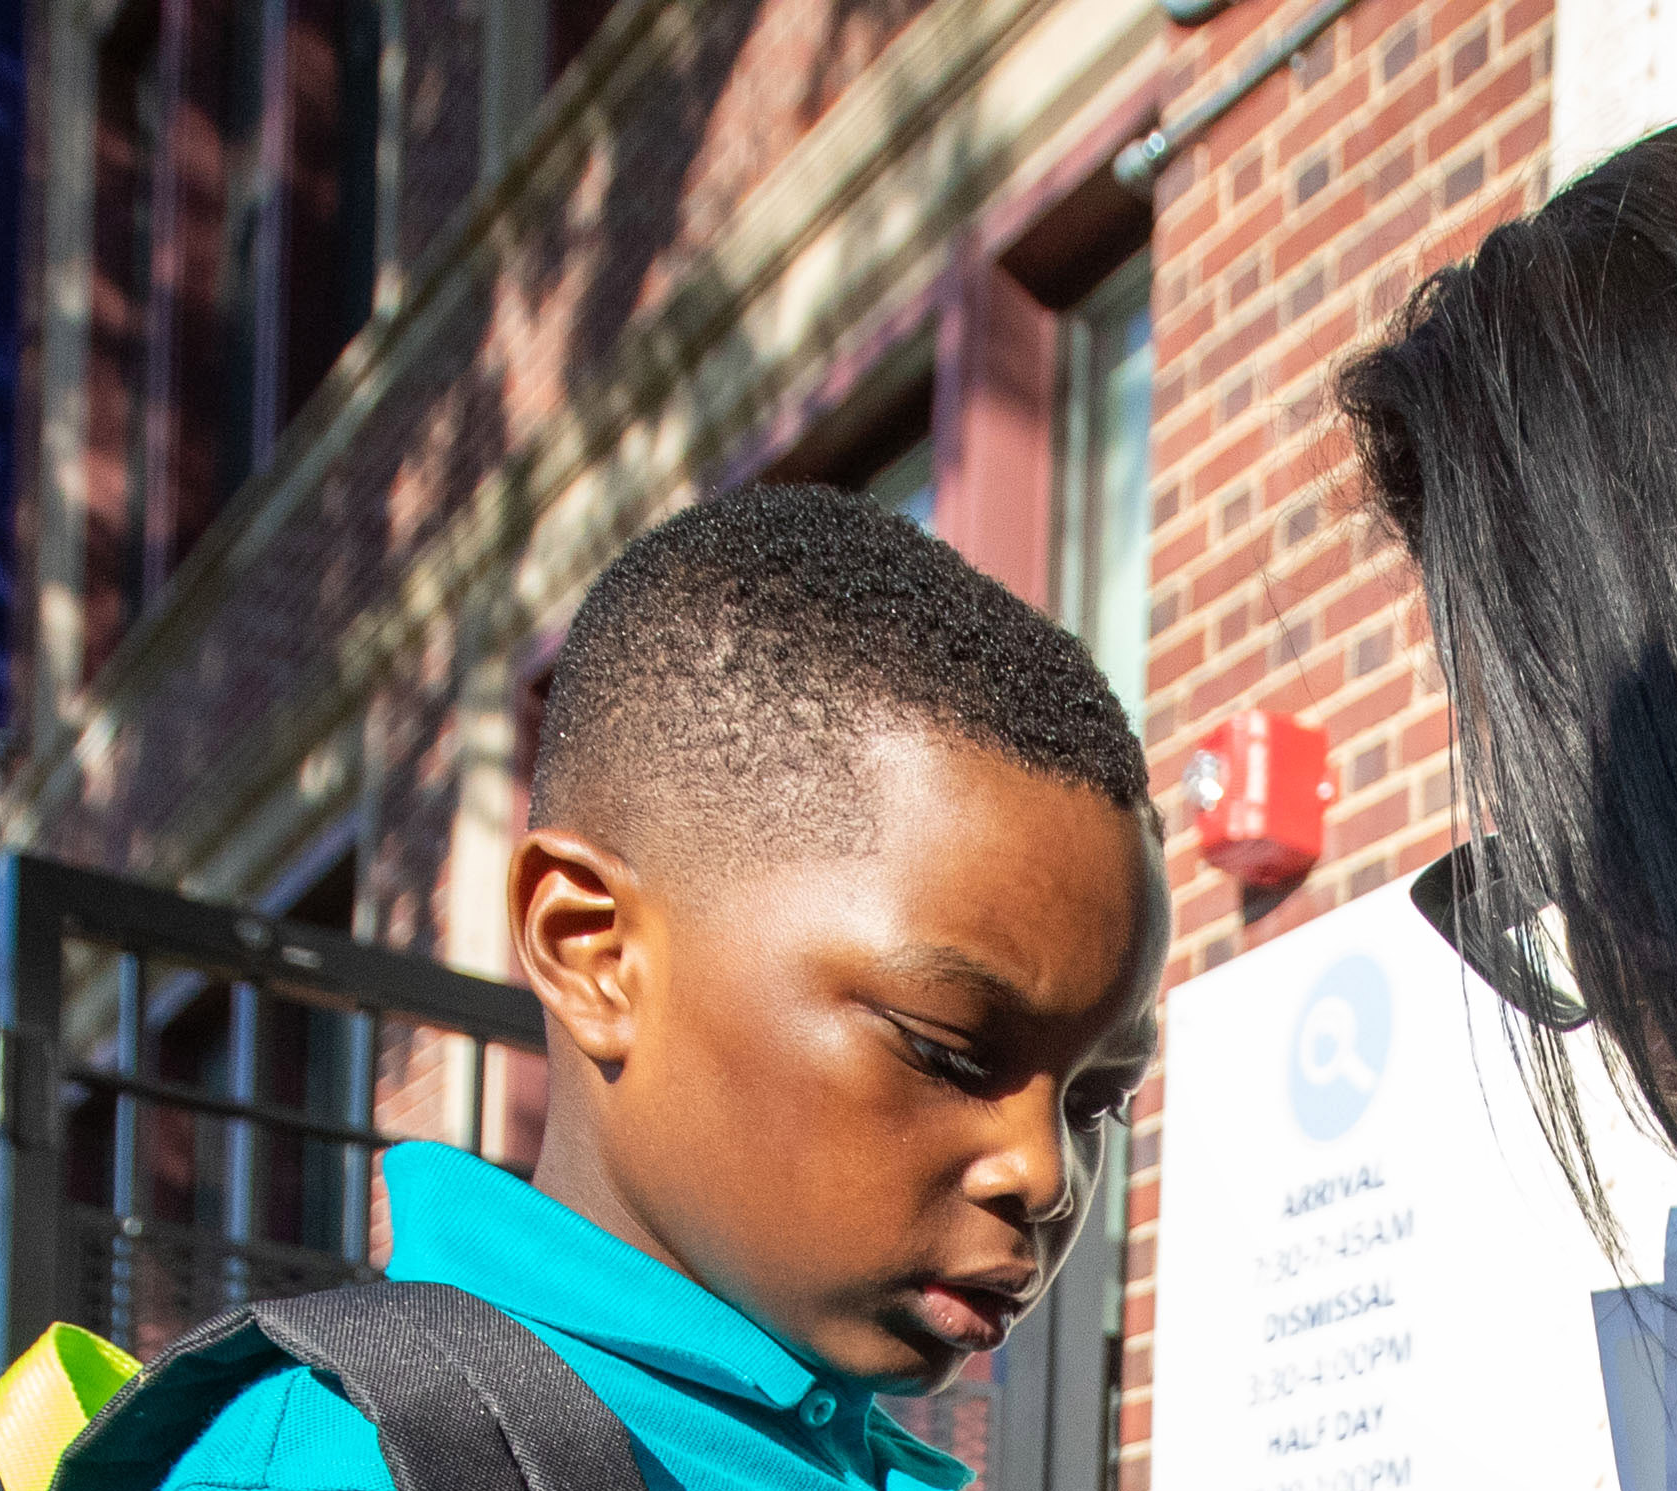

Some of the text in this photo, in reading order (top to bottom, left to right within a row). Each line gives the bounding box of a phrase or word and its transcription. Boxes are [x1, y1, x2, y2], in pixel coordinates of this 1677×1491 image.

[1283, 1157, 1384, 1218] ARRIVAL
[1266, 1280, 1395, 1342] DISMISSAL
[1269, 1402, 1384, 1456] HALF DAY
